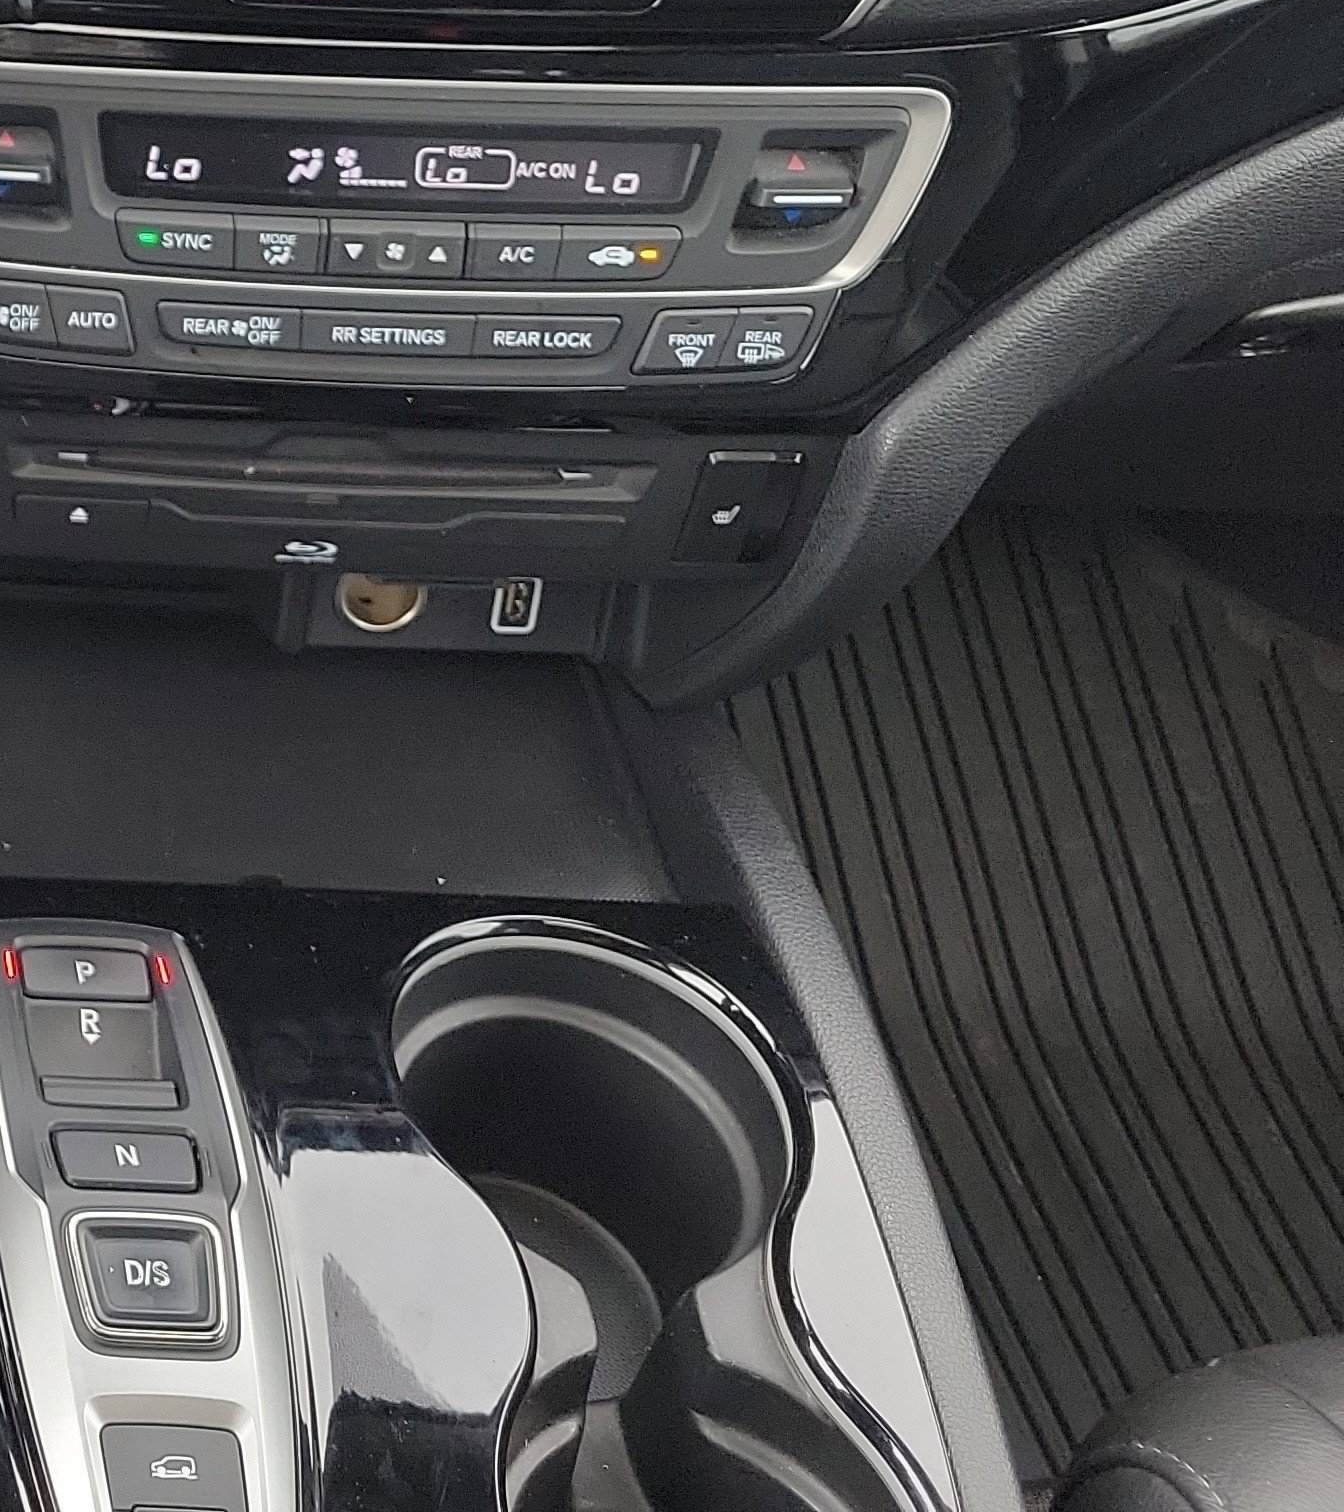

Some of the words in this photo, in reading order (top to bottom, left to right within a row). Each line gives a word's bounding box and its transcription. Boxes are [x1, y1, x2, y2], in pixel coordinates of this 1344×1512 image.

[448, 145, 483, 160] REAR
[146, 145, 202, 181] Lo
[425, 157, 468, 183] Lo
[515, 161, 549, 178] A/C
[551, 163, 576, 179] ON
[585, 159, 640, 194] Lo
[161, 232, 212, 251] SYNC
[259, 233, 297, 245] MODE
[498, 246, 535, 263] A/C
[10, 303, 40, 317] ON/
[10, 317, 40, 332] OFF
[67, 311, 117, 329] AUTO
[183, 317, 229, 336] REAR
[249, 316, 281, 330] ON/
[247, 330, 281, 345] OFF
[331, 326, 357, 344] RR
[359, 327, 446, 346] SETTINGS
[493, 330, 540, 347] REAR
[543, 331, 592, 349] LOCK
[668, 333, 716, 347] FRONT
[745, 330, 782, 344] REAR
[75, 960, 96, 983] P
[78, 1007, 100, 1033] R
[114, 1144, 138, 1168] N
[125, 1259, 171, 1287] D/S
